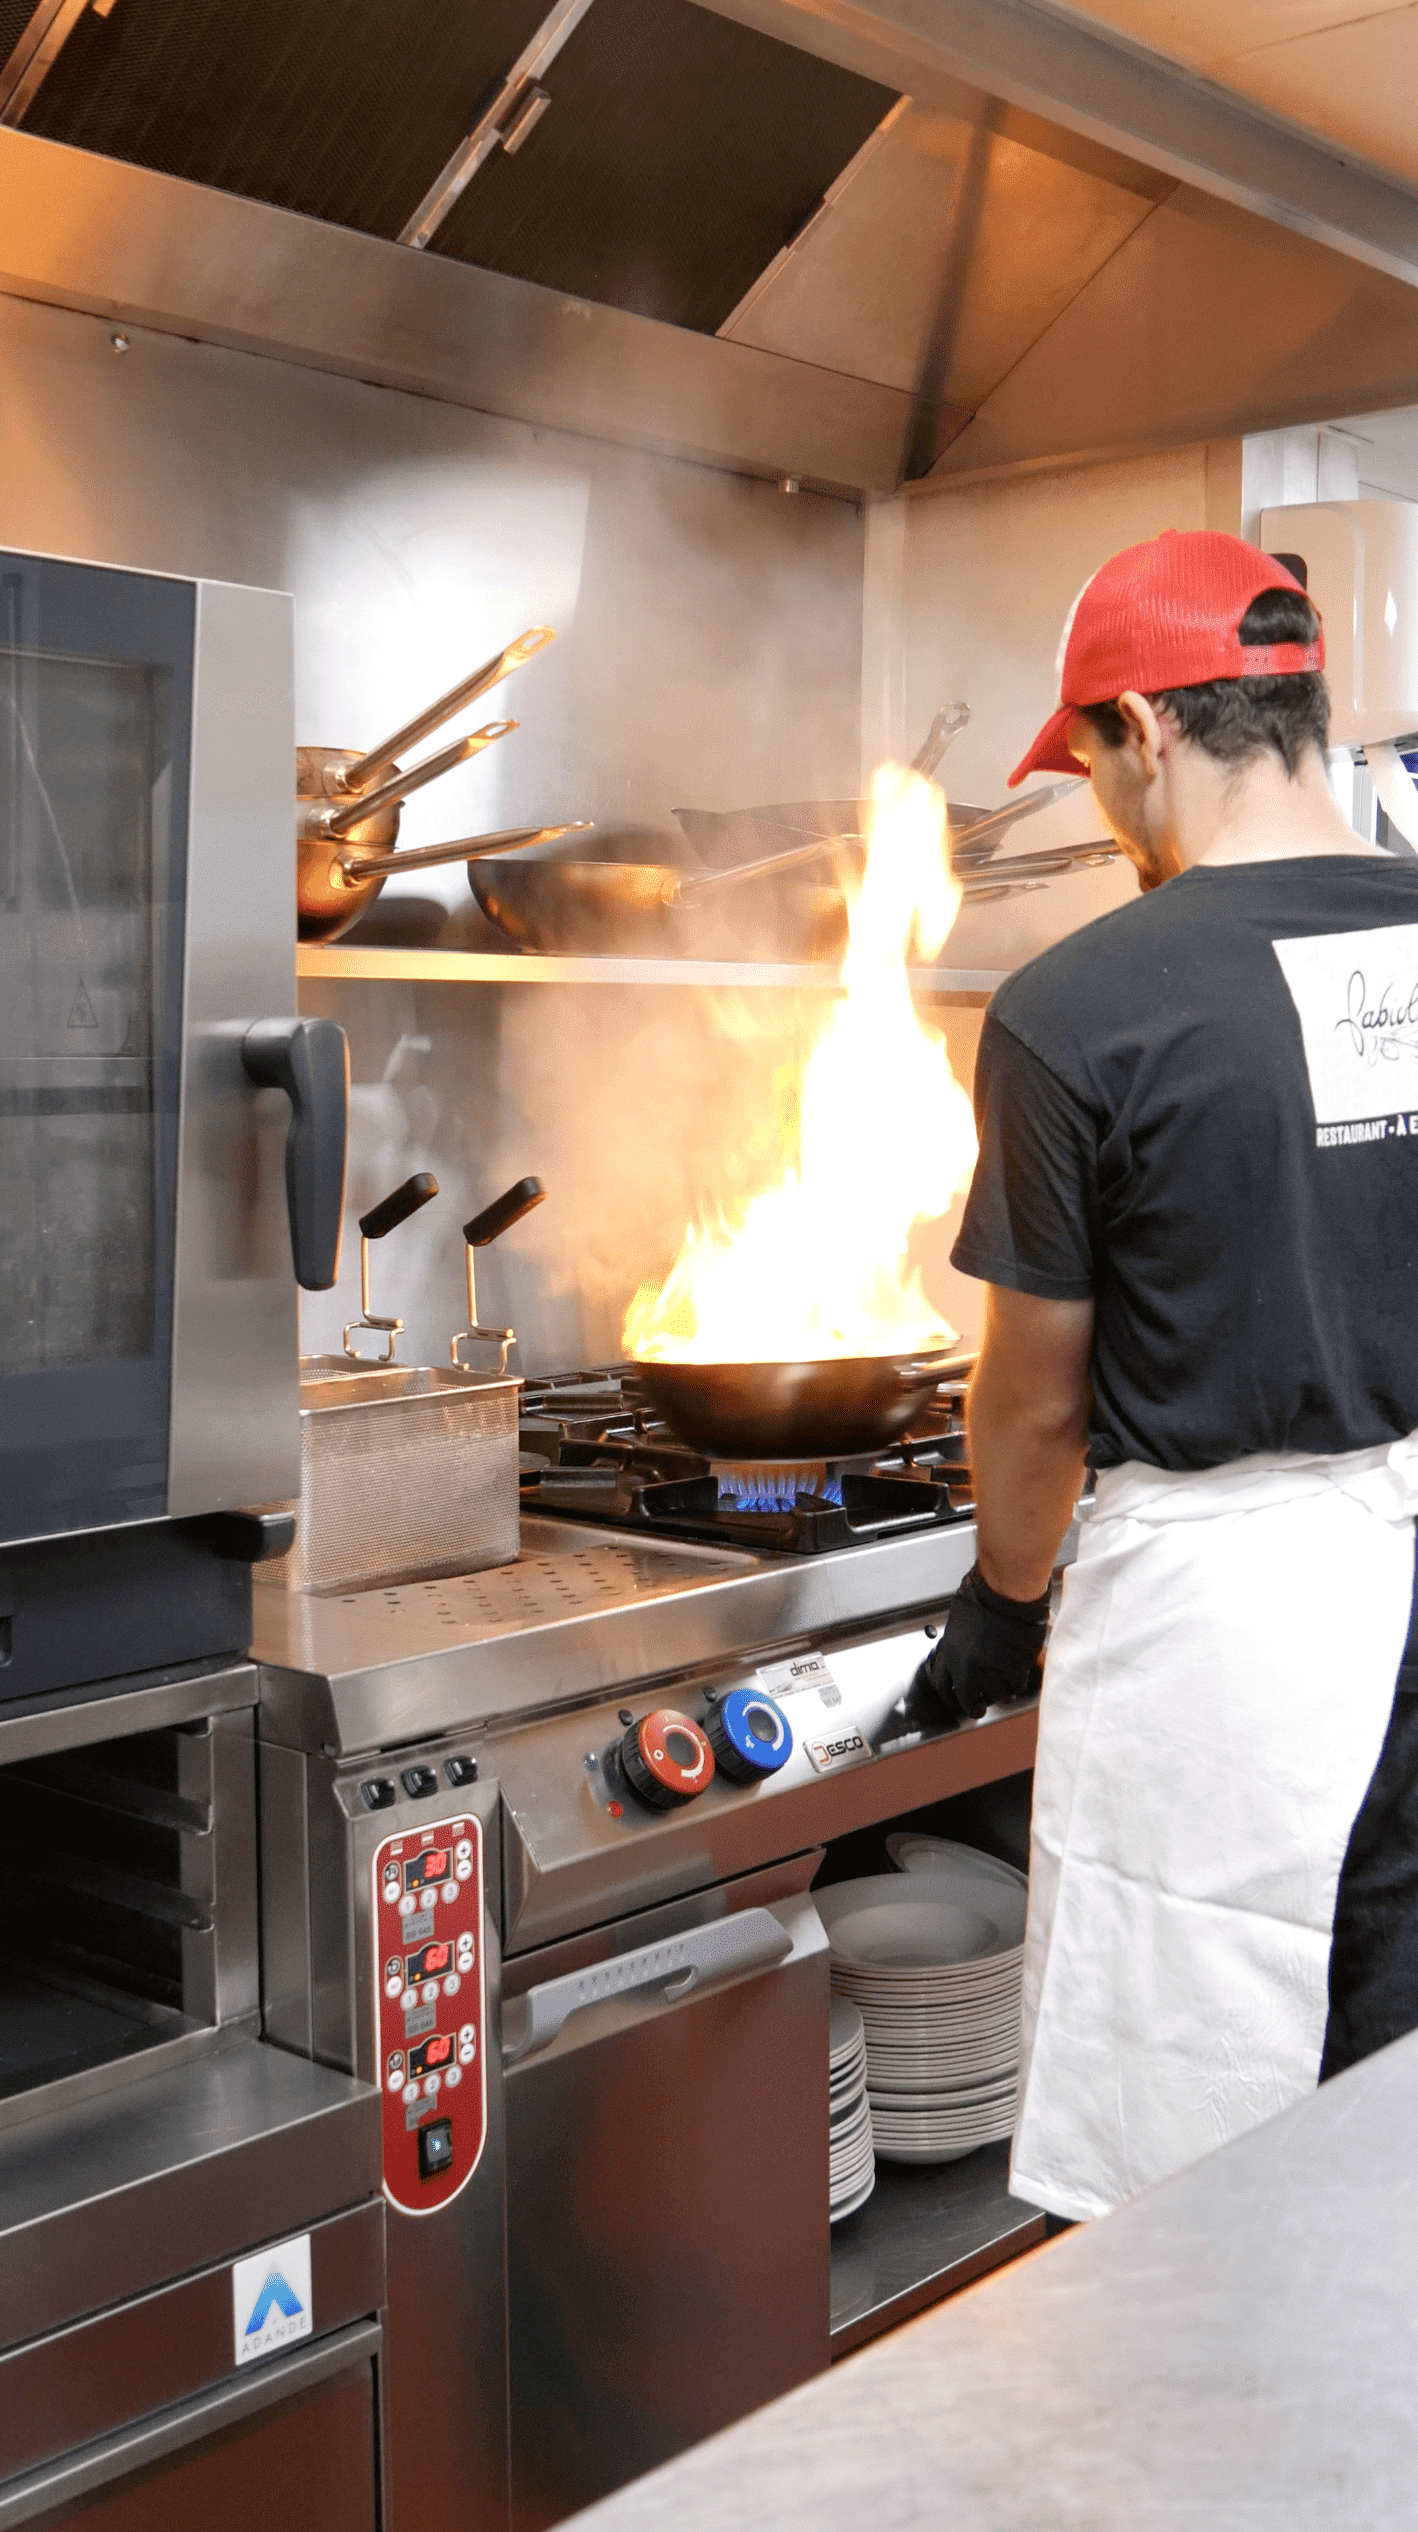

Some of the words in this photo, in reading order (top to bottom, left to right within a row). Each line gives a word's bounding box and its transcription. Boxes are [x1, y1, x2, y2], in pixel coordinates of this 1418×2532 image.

[1316, 1119, 1387, 1147] RESTAURANT
[790, 1660, 820, 1677] dima
[424, 1851, 448, 1878] 30
[242, 2316, 306, 2353] ADANDE
